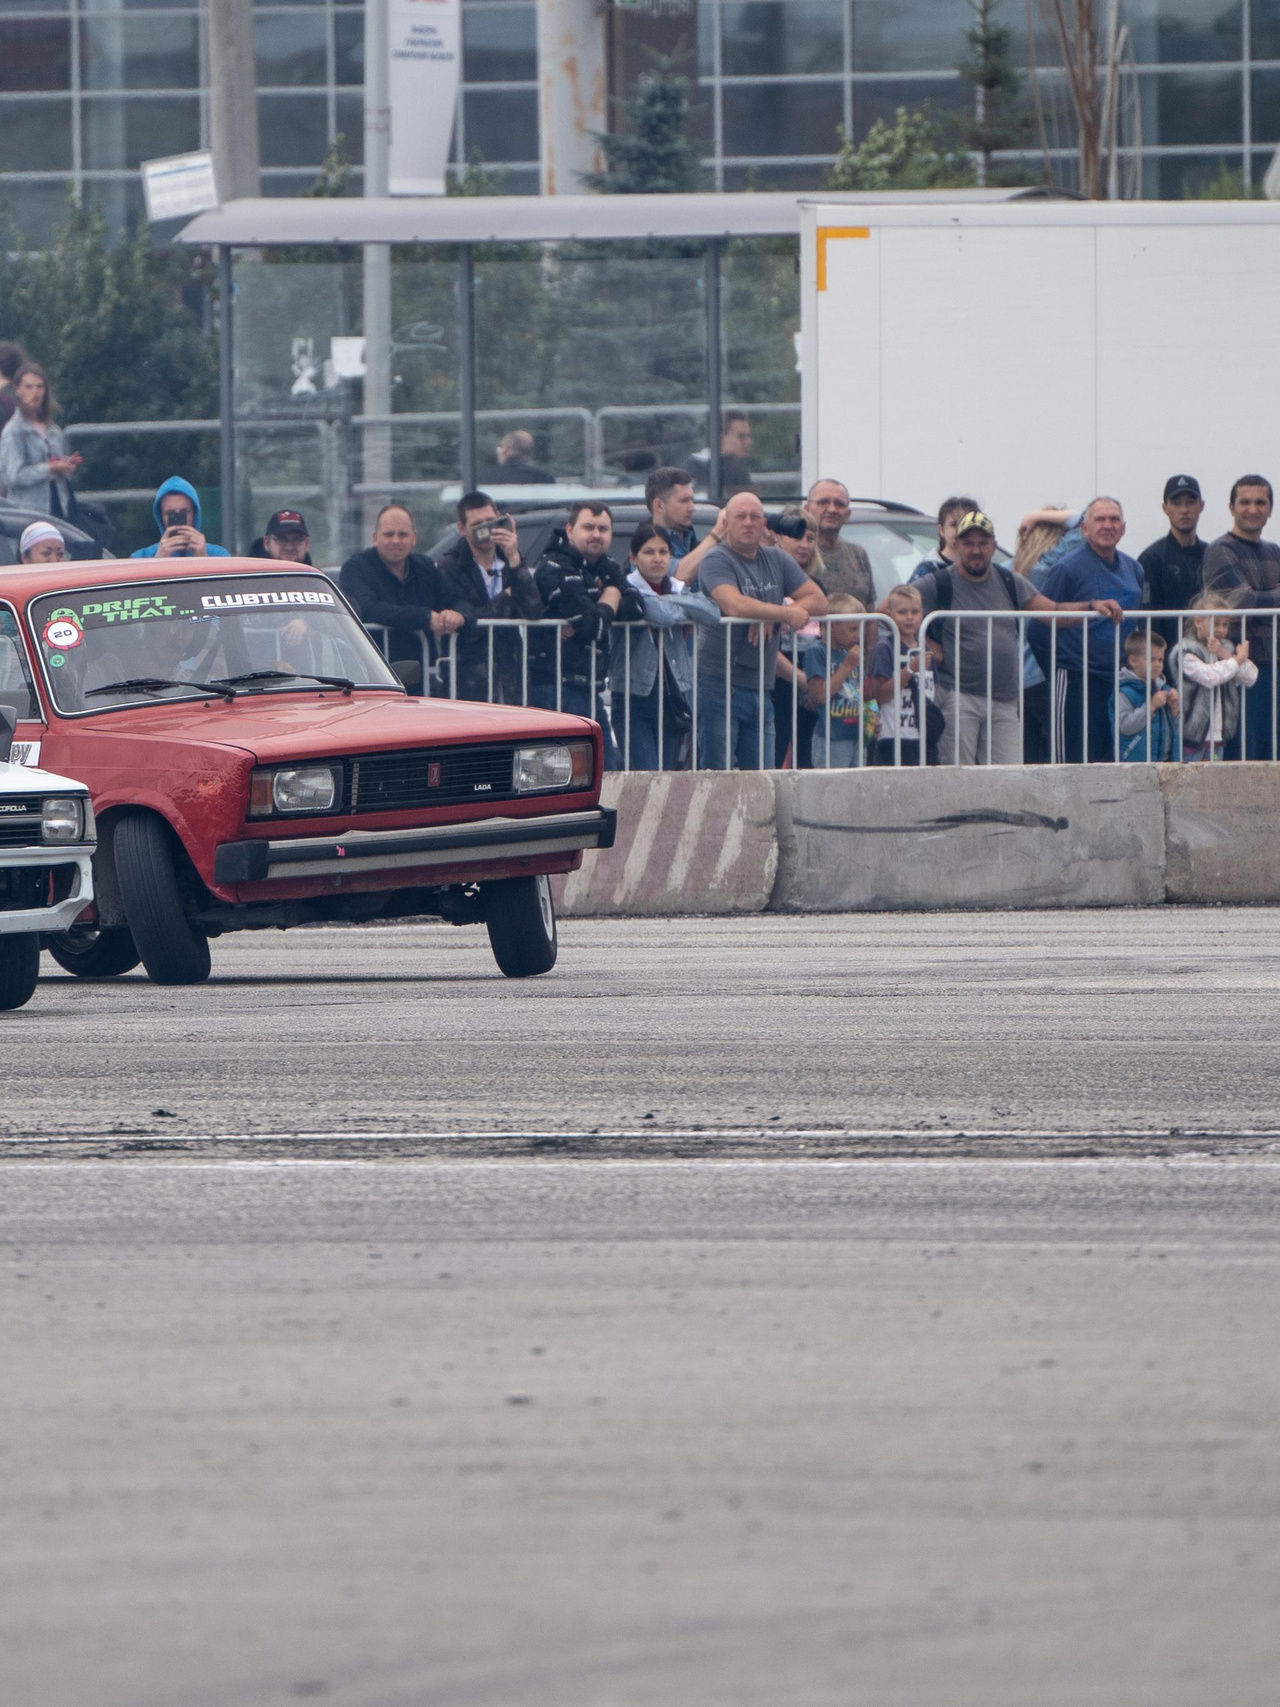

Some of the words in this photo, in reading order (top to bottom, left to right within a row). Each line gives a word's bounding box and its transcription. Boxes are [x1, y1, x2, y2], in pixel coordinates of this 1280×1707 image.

[82, 596, 168, 615] DRIFT
[201, 592, 335, 608] CLUBTURBO
[53, 629, 73, 638] 20
